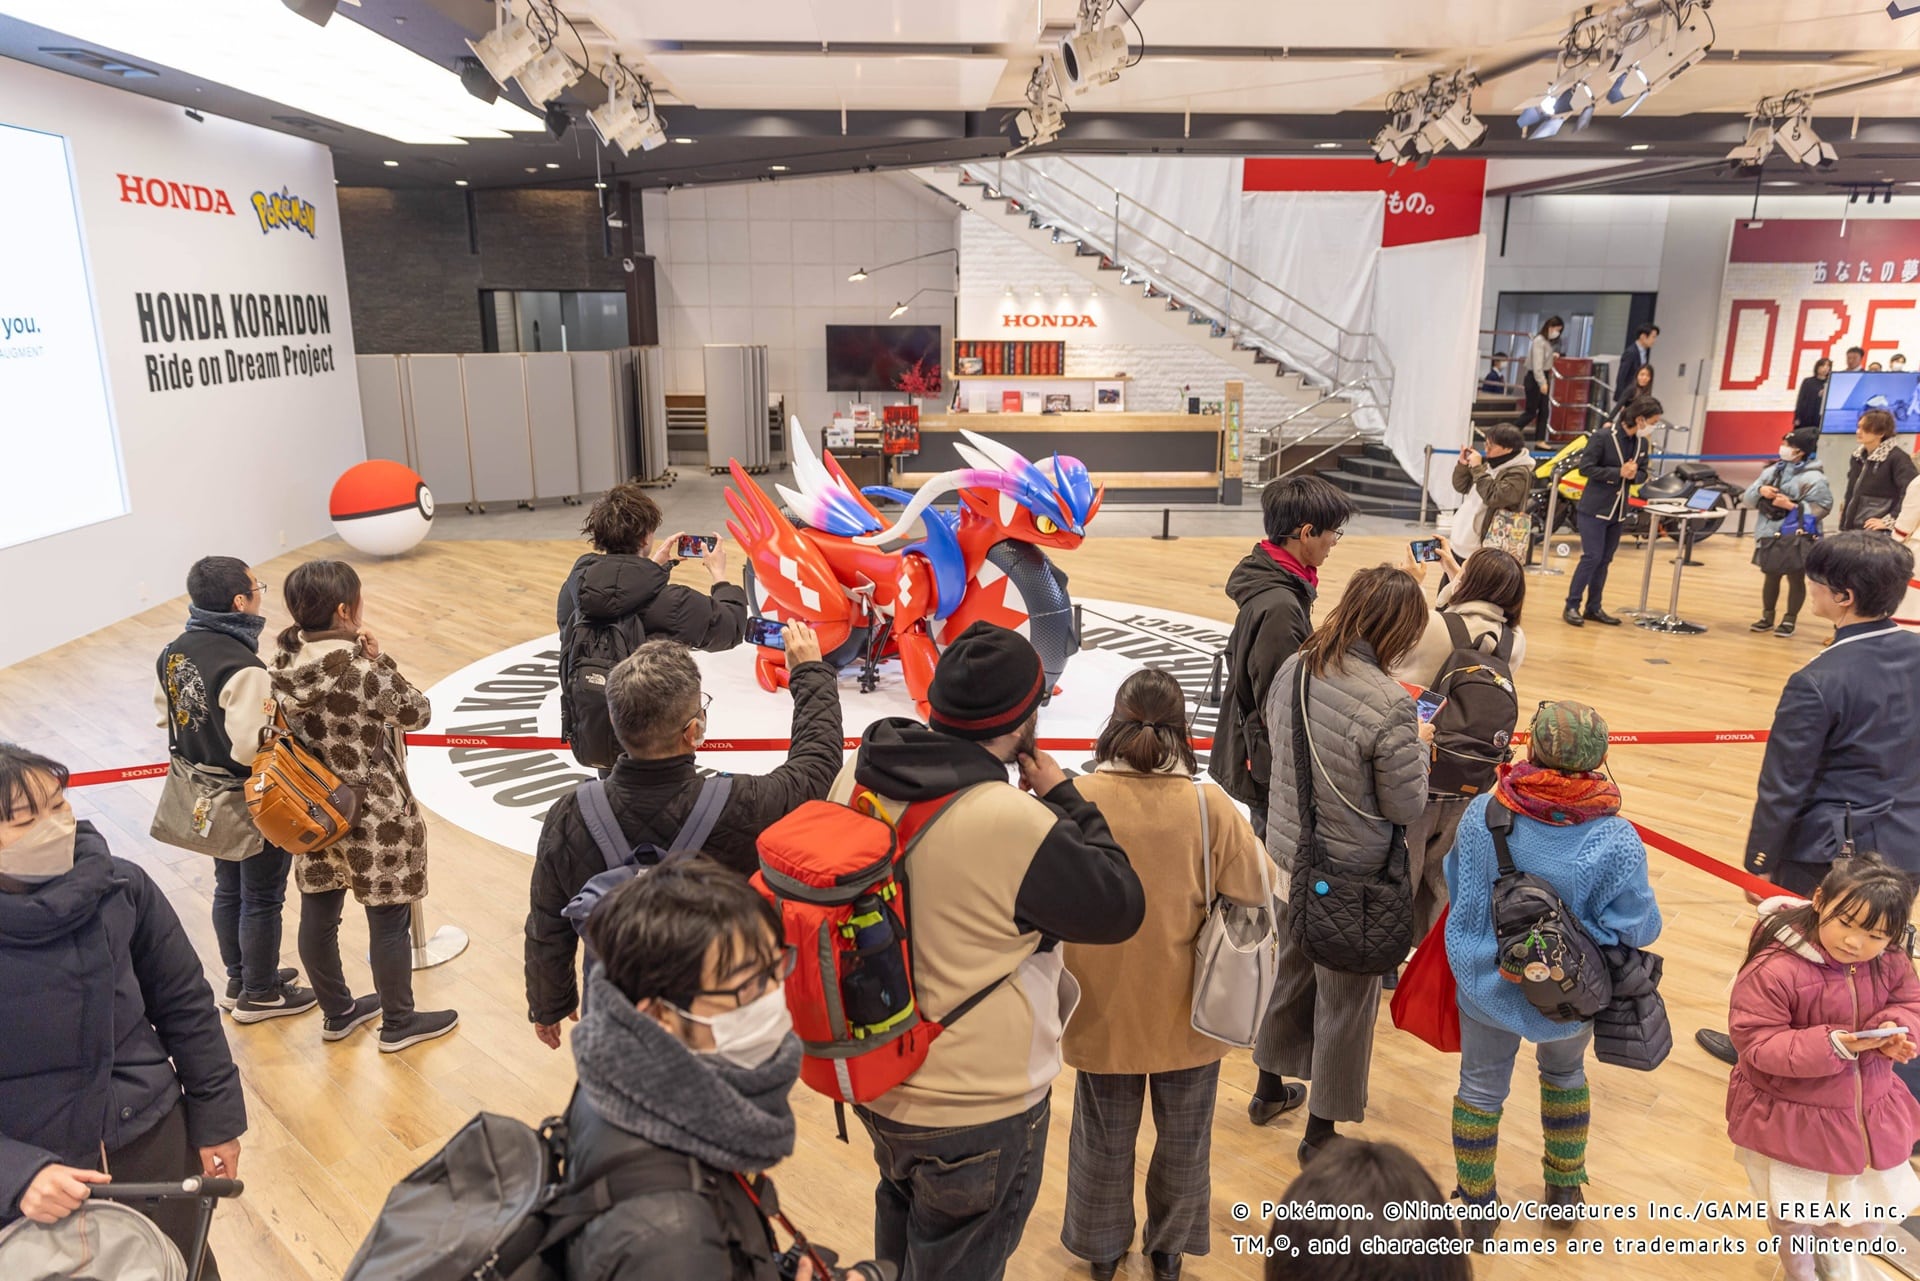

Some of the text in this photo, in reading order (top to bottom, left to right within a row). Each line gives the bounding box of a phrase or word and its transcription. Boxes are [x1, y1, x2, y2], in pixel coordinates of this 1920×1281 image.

[116, 173, 236, 215] HONDA
[1387, 190, 1435, 215] もの。
[1813, 259, 1920, 282] あなたの夢
[1, 317, 41, 340] you.
[135, 292, 331, 343] HONDA KORAIDON
[1002, 314, 1098, 328] HONDA
[145, 343, 335, 393] Ride on Dream Project
[446, 738, 488, 746] HONDA
[1715, 733, 1755, 741] HONDA
[445, 717, 598, 823] ONDA
